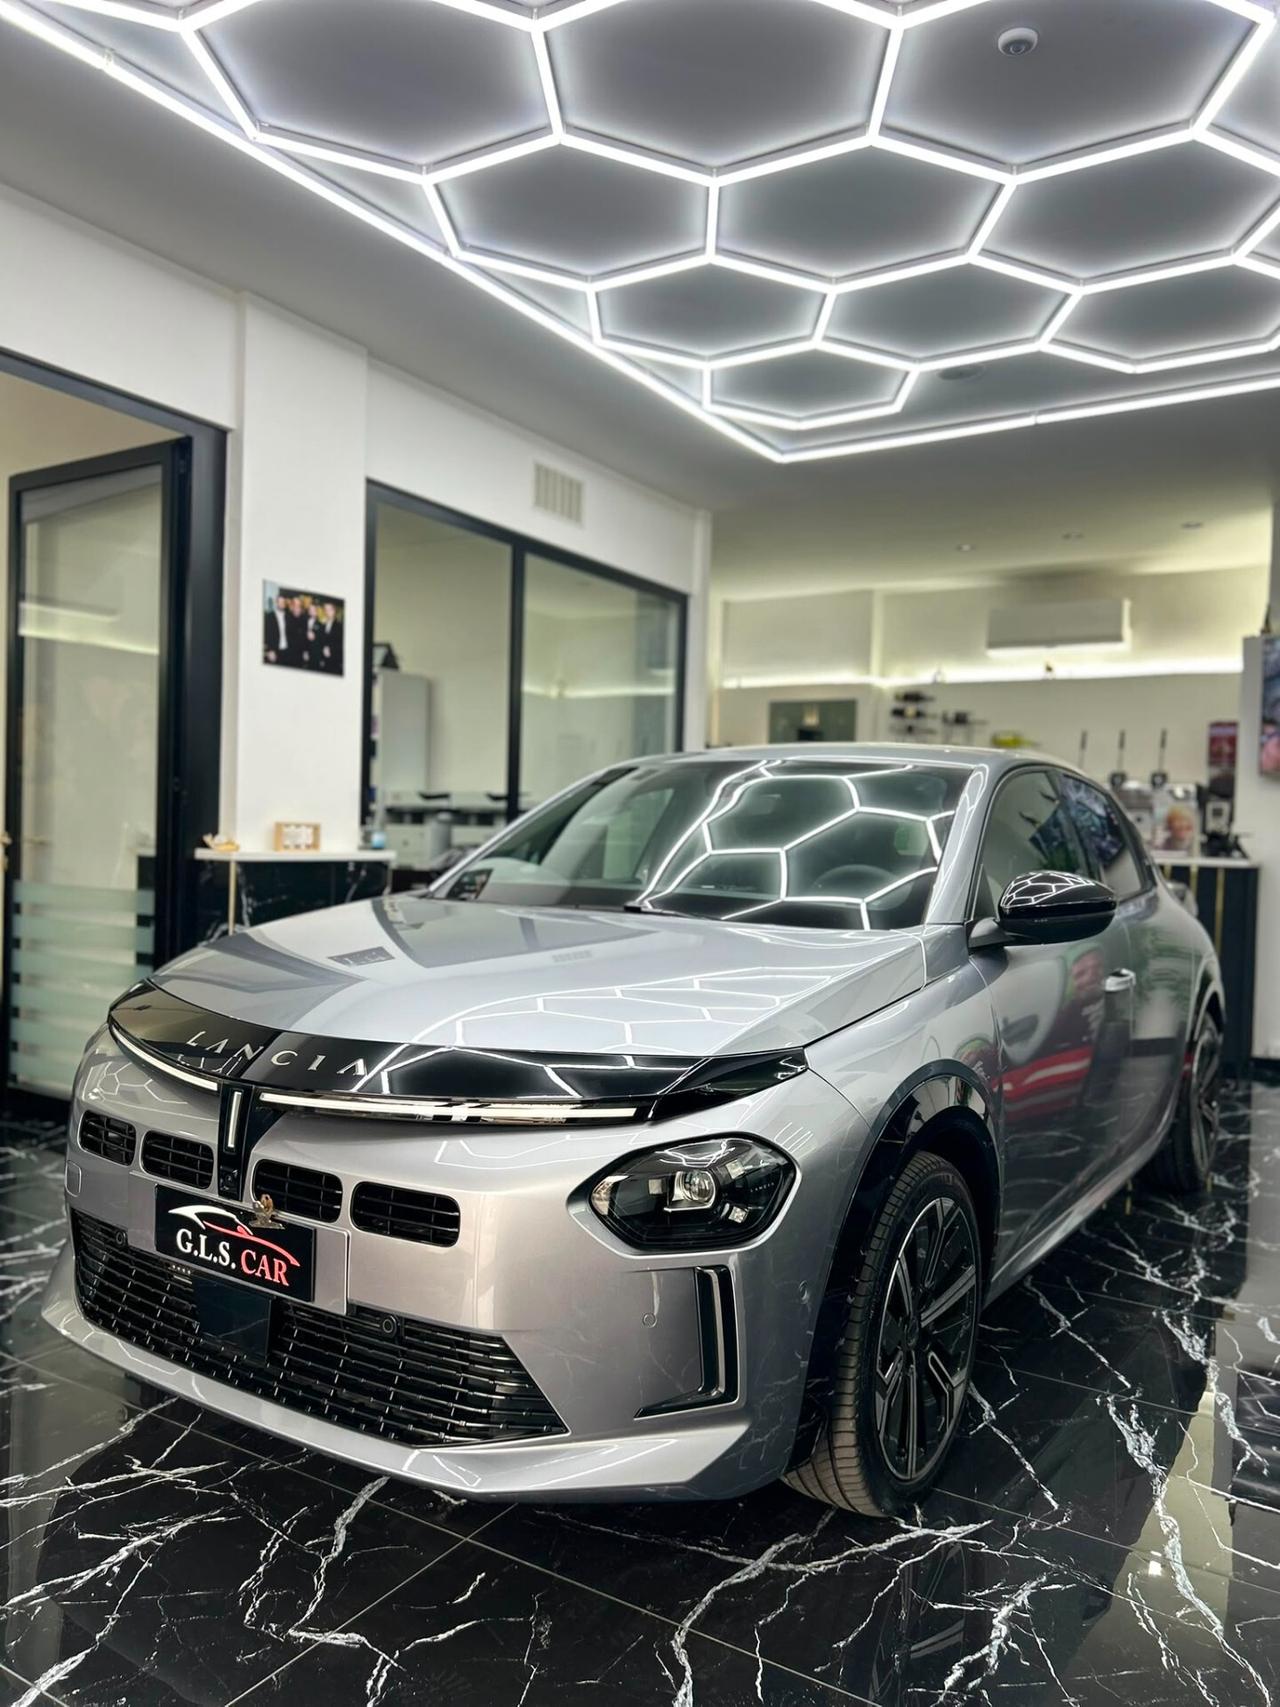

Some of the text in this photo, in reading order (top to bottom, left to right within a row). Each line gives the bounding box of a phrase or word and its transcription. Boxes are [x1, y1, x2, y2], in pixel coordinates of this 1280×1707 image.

[186, 1030, 368, 1076] LANCIA
[175, 1228, 289, 1287] G.L.S. CAR
